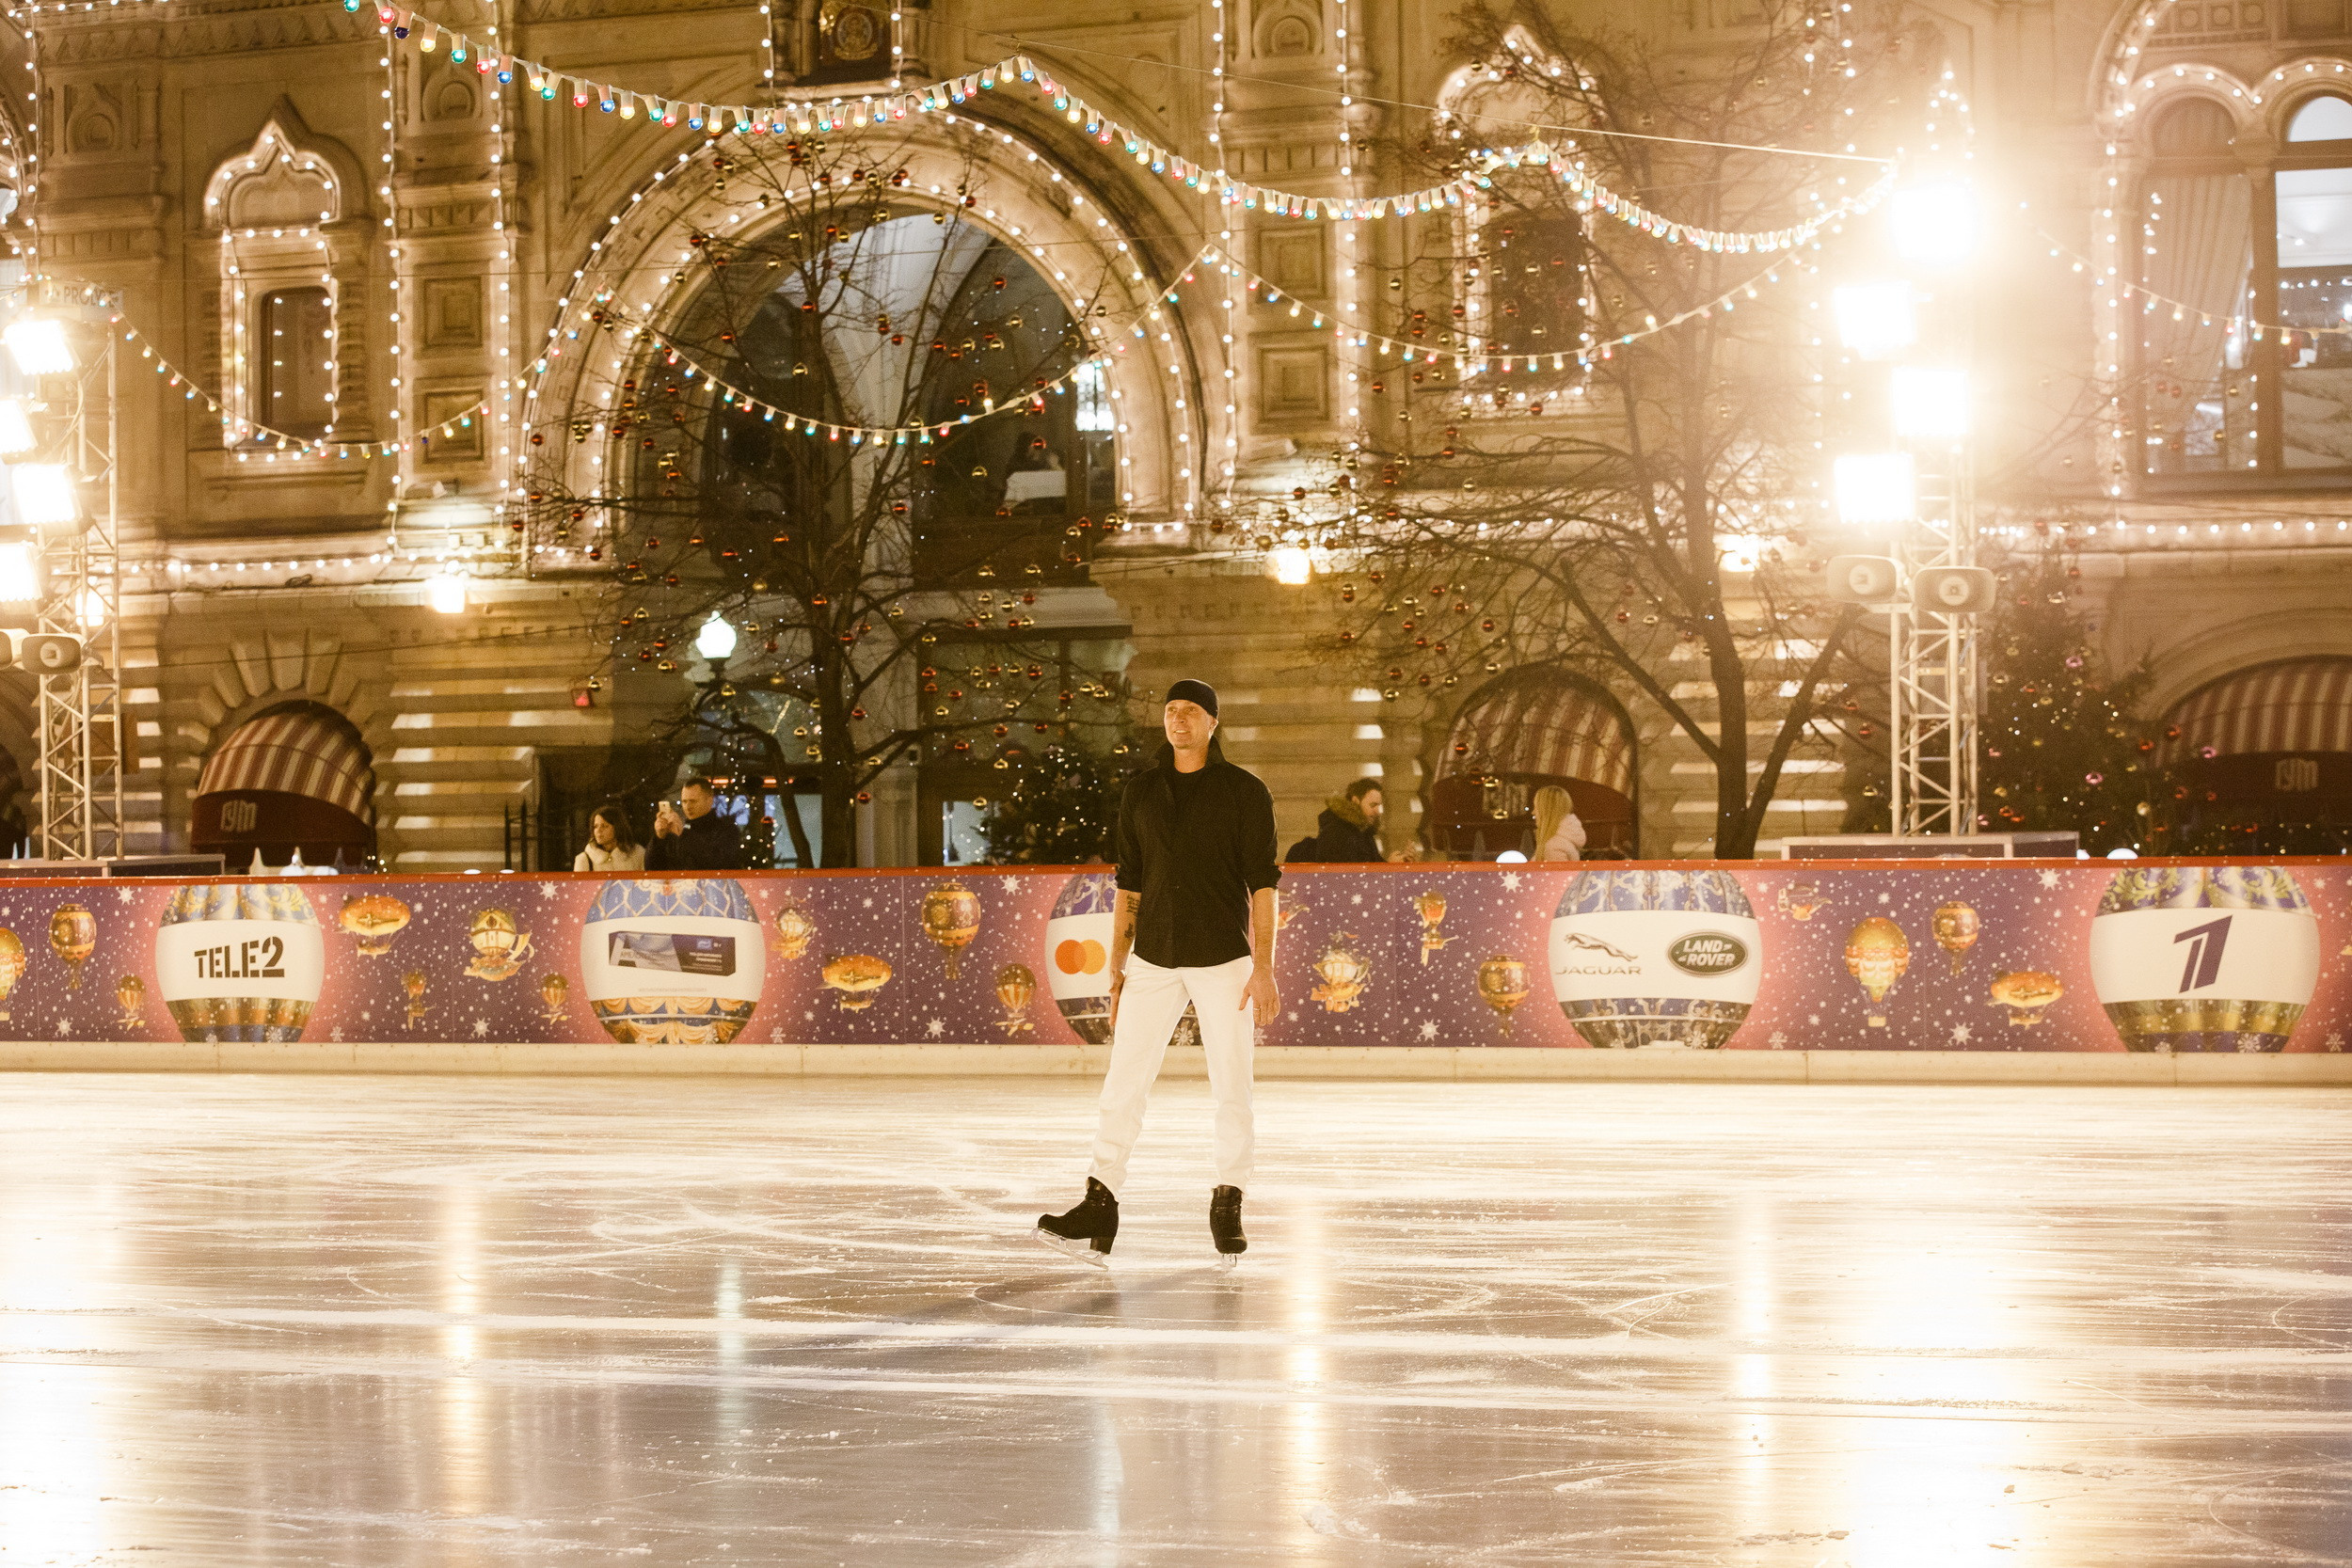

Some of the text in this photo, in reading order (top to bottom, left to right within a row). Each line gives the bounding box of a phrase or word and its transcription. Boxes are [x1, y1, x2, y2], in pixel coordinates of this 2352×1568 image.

[1683, 940, 1723, 953] LAND
[194, 936, 285, 978] TELE2
[1687, 953, 1736, 966] ROVER
[1555, 965, 1642, 975] JAGUAR
